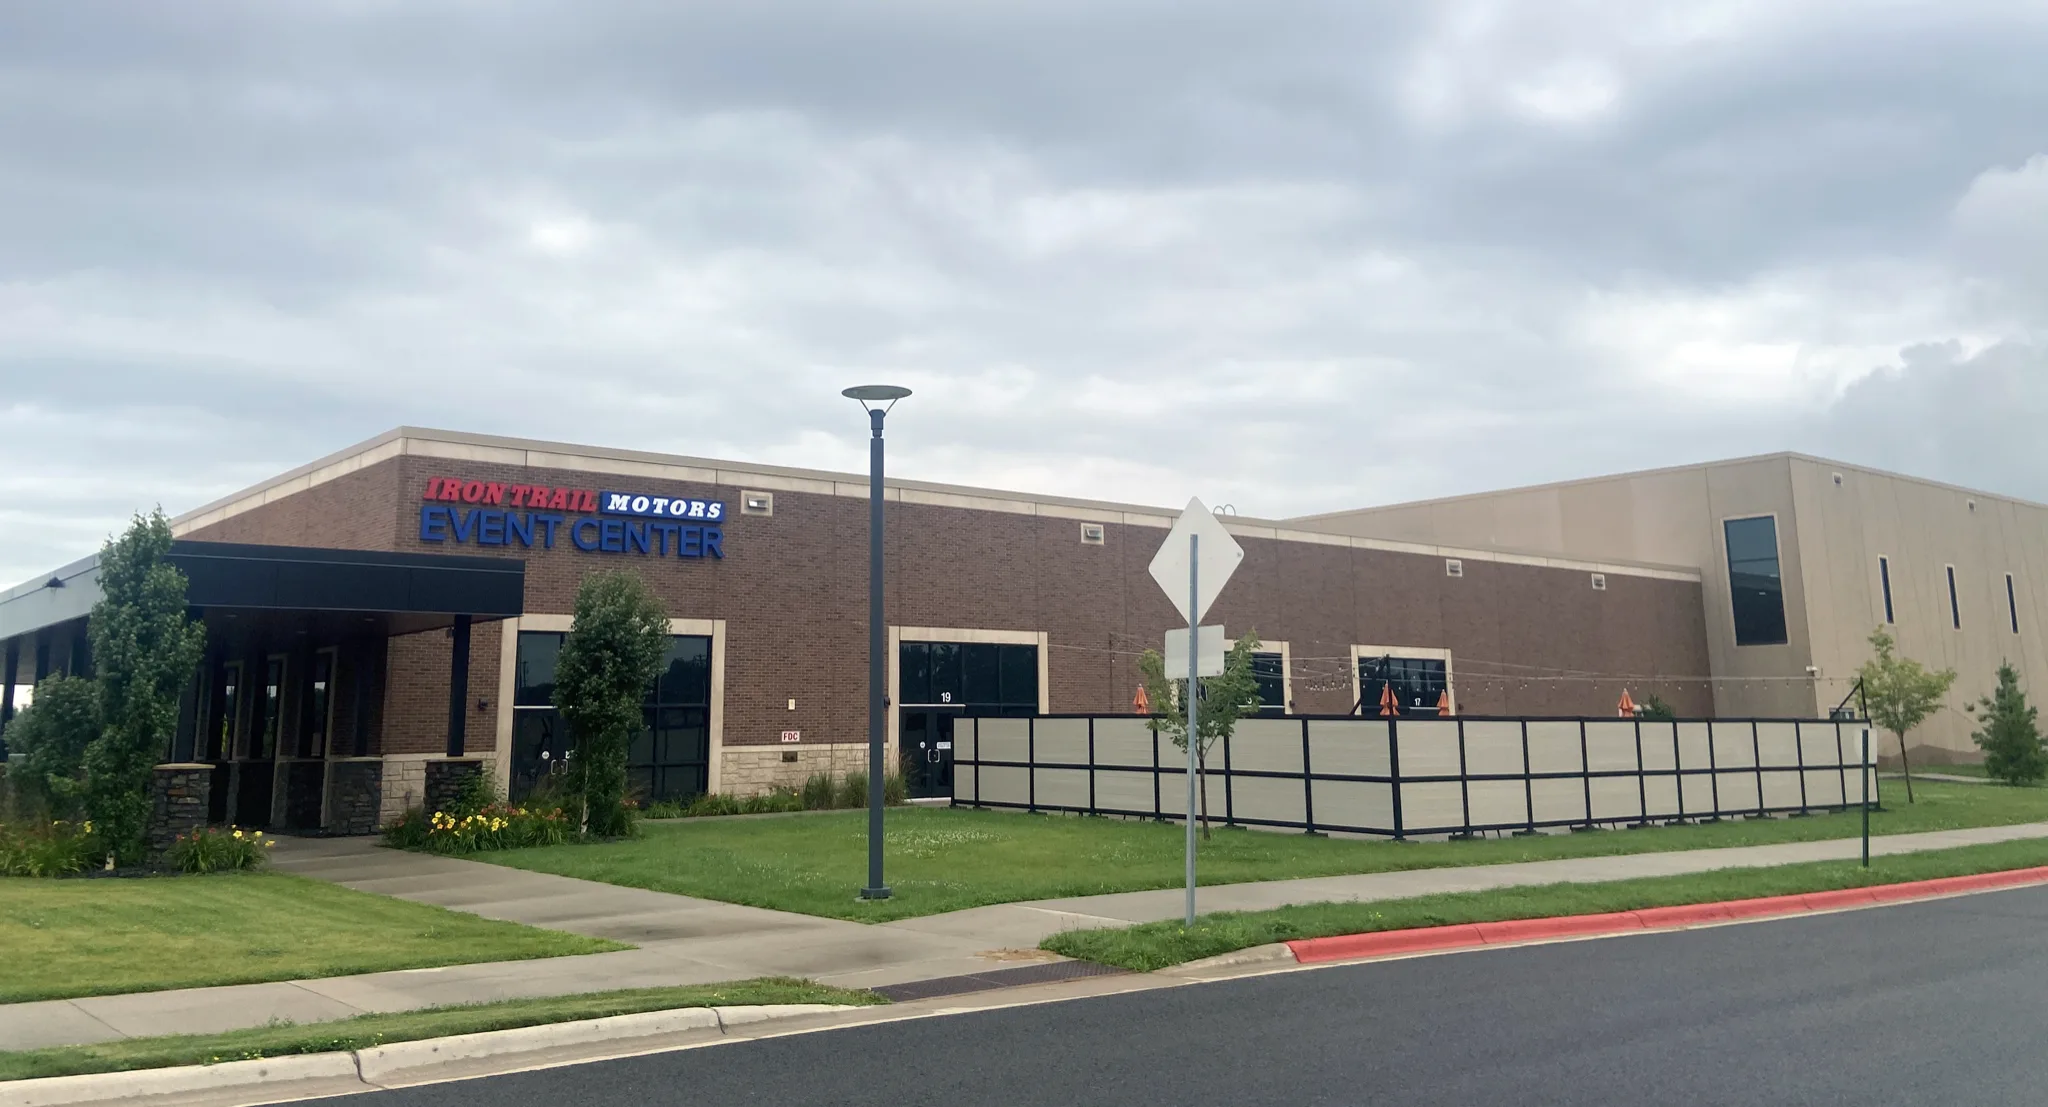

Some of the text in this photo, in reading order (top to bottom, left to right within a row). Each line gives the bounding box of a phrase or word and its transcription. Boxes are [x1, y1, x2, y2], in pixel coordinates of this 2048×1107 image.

[423, 477, 721, 518] IRON TRAIL MOTORS
[420, 506, 725, 558] EVENT CENTER
[941, 692, 951, 702] 19
[1414, 697, 1421, 706] 17
[783, 732, 798, 740] FDC
